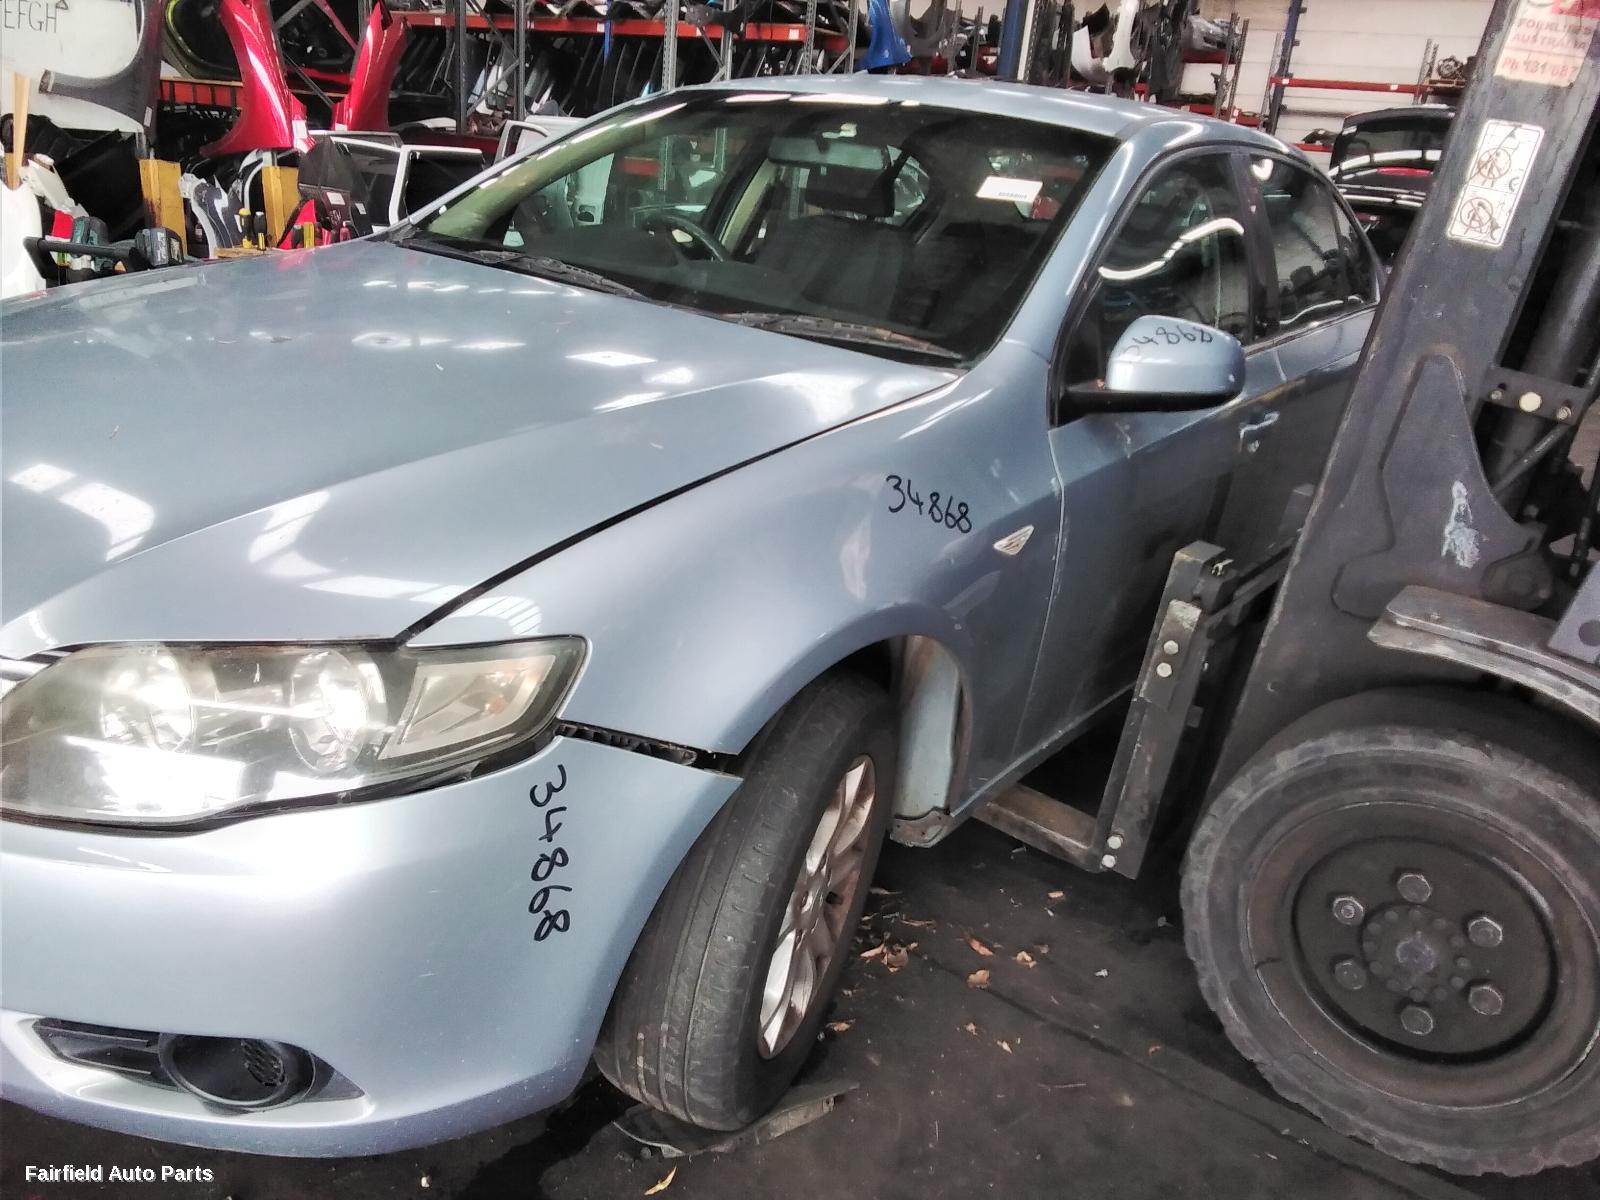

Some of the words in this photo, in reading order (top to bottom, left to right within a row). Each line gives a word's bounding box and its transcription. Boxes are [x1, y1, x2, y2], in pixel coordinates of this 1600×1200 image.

[4, 0, 57, 33] EFGH
[886, 474, 972, 534] 34868
[528, 763, 573, 942] 34868
